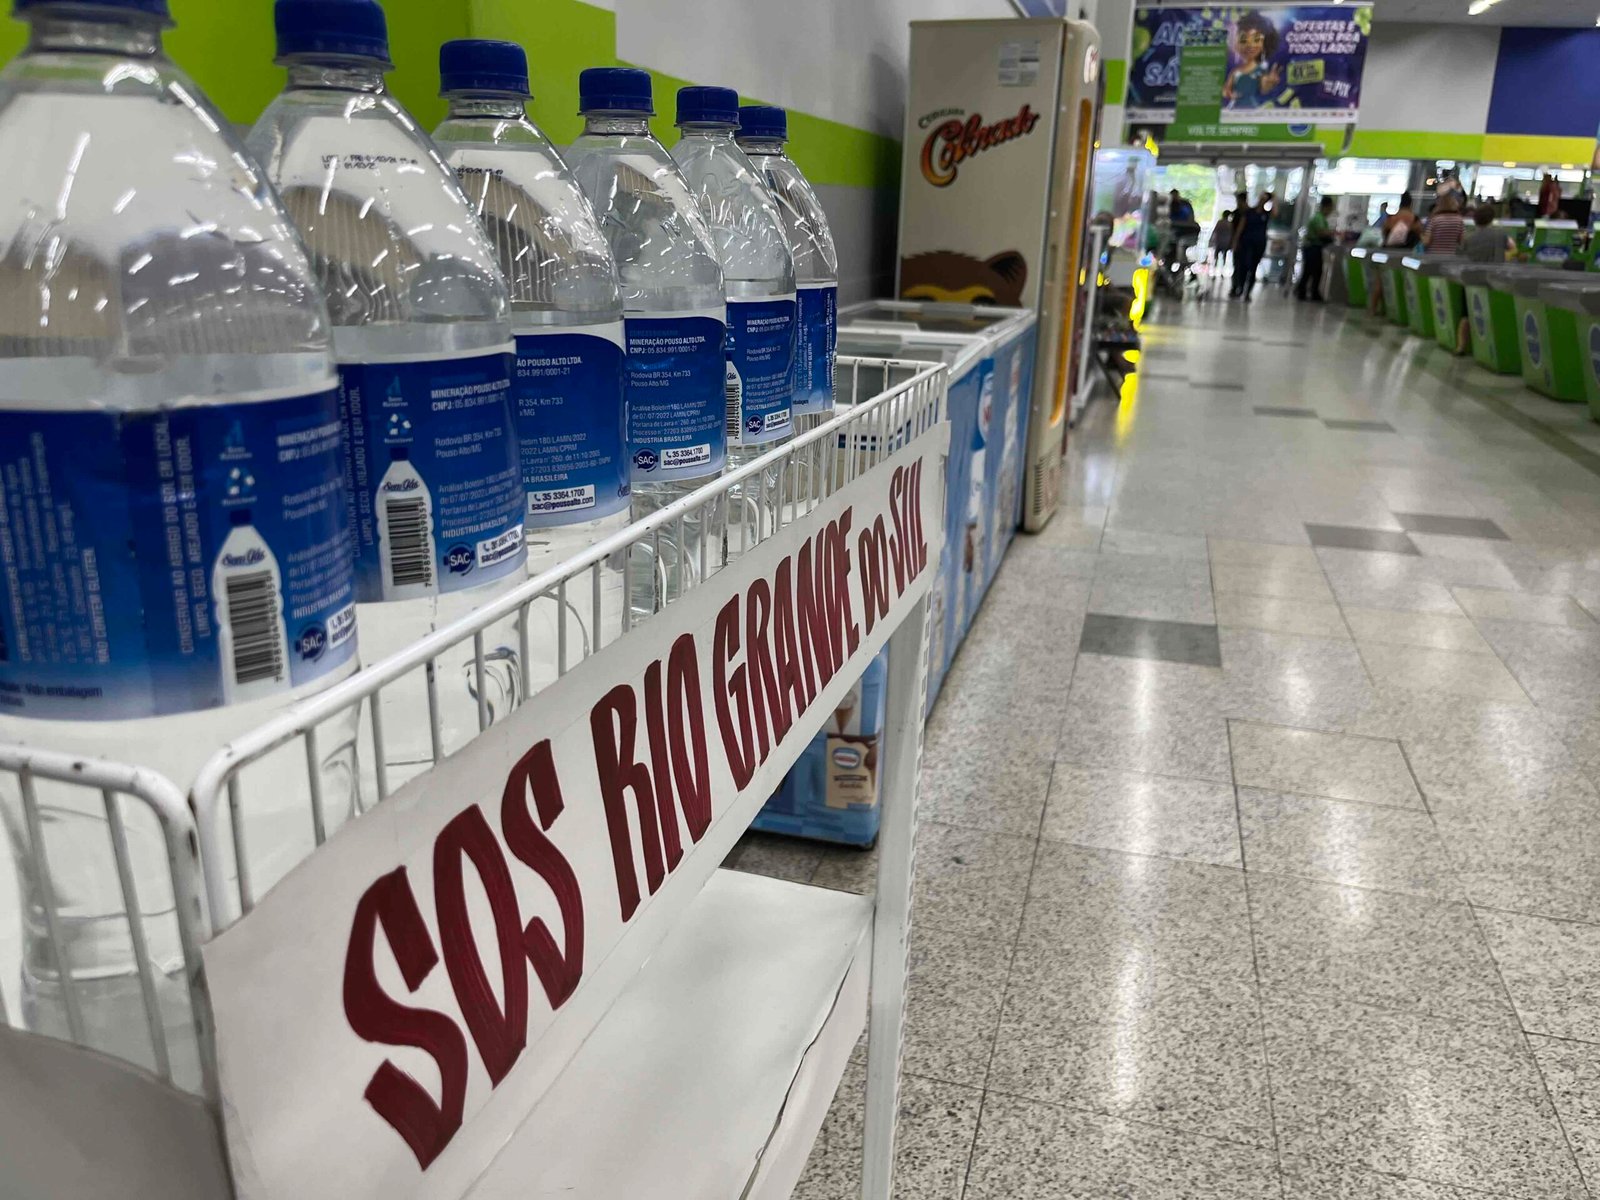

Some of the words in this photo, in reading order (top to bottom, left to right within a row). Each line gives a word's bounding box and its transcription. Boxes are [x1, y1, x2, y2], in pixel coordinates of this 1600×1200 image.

[630, 337, 664, 346] MINERAÇÃO
[664, 337, 682, 345] POUSO
[527, 357, 551, 367] POUSO
[551, 356, 566, 366] ALTO
[431, 384, 474, 399] MINERAÇÃO
[748, 420, 761, 429] SAC
[155, 420, 172, 458] LOCAL
[637, 455, 654, 466] SAC
[672, 450, 680, 458] 35
[159, 460, 174, 478] EM
[530, 472, 569, 483] BRASILEIRA
[161, 480, 177, 504] SOL
[177, 474, 195, 501] SEM
[542, 491, 552, 501] 35
[553, 487, 585, 499] 3364.1700
[183, 502, 198, 510] E
[531, 495, 594, 511] sac@pousoalto.com
[164, 505, 179, 523] DO
[184, 513, 202, 563] AREJADO
[166, 526, 183, 567] ABRIGO
[449, 551, 472, 568] SAC
[171, 570, 186, 586] AO
[174, 589, 195, 654] CONSERVAR
[301, 633, 324, 653] SAC
[343, 738, 585, 1172] SOS
[590, 633, 713, 923] RIO
[713, 505, 860, 792] GRANDE
[858, 513, 890, 637] DO
[889, 456, 928, 599] SUL
